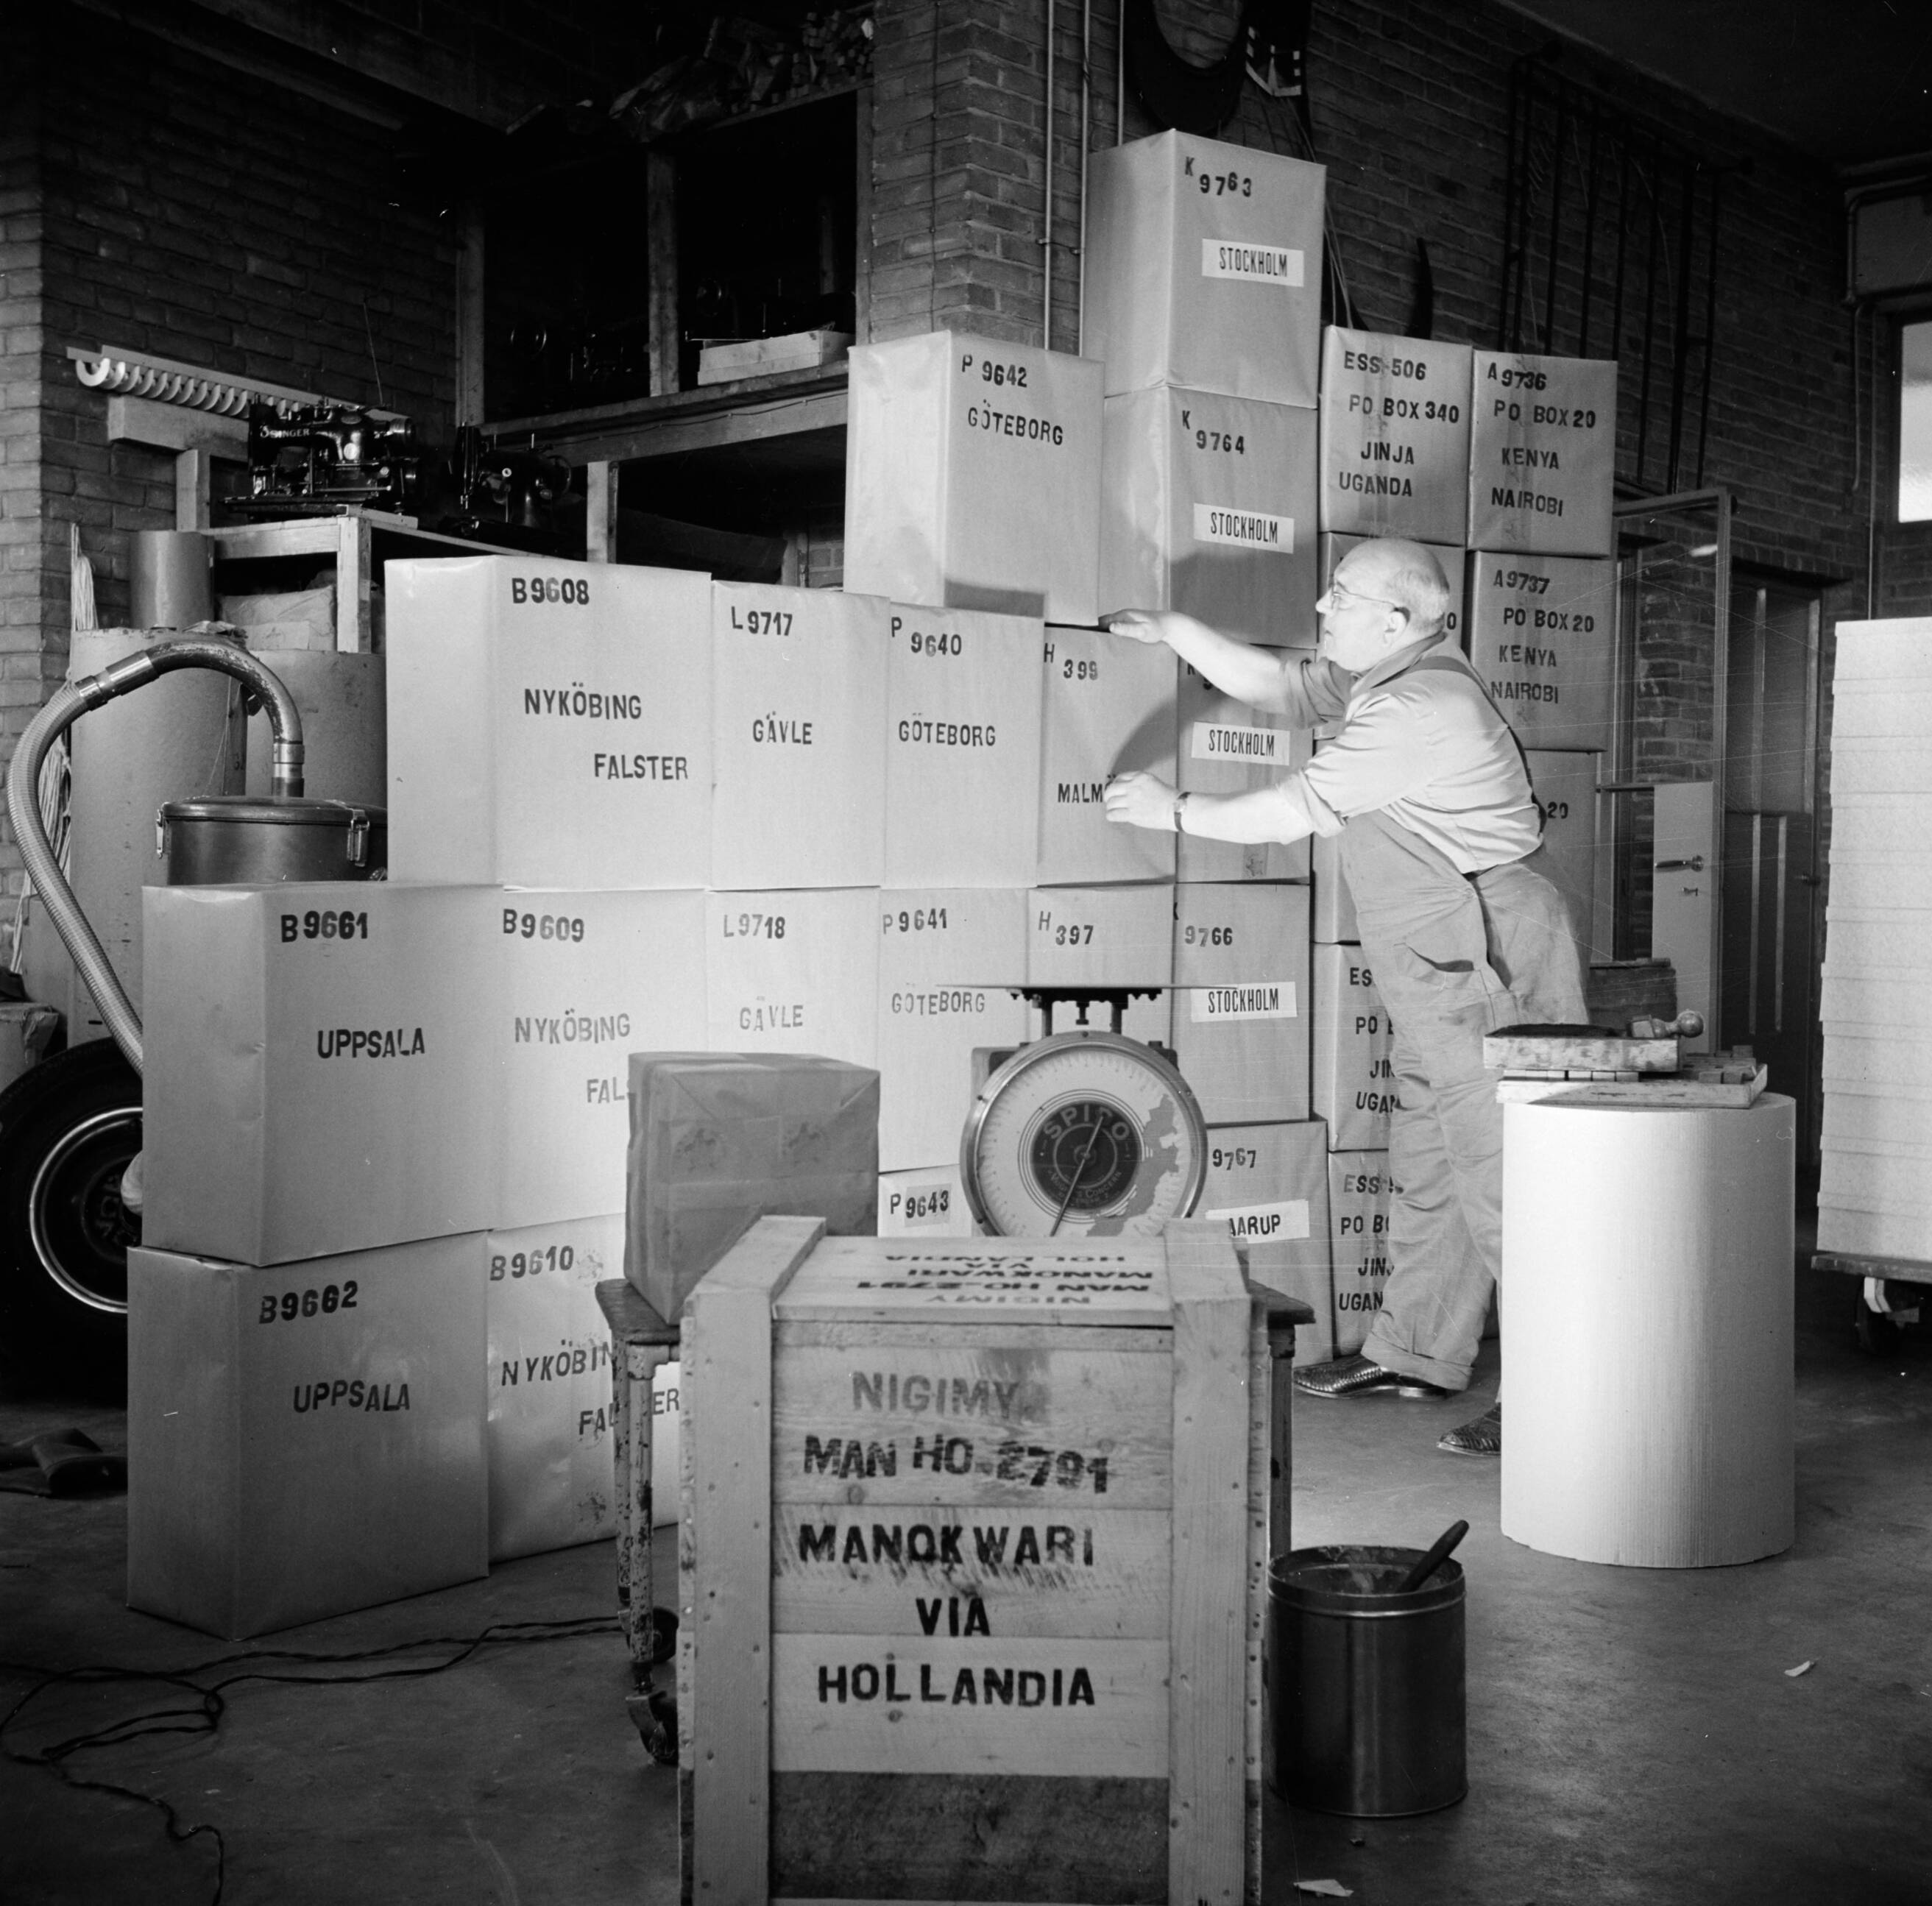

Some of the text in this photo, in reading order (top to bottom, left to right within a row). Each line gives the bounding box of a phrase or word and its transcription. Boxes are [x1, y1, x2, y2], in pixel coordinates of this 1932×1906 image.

[1184, 156, 1252, 198] K 9763
[1219, 247, 1287, 276] STOCKHOLM
[961, 354, 1027, 388] P 9642
[1391, 358, 1427, 381] 506
[967, 399, 1064, 446] GÖTEBORG
[1348, 394, 1459, 424] PO BOX 340
[1493, 399, 1596, 429] PO BOX 20
[1181, 410, 1245, 455] K 9764
[1360, 441, 1415, 465] JINJA
[1501, 447, 1560, 470] KENYA
[1339, 471, 1412, 497] UGANDA
[1491, 486, 1563, 517] NAIROBI
[1210, 511, 1278, 543] STOCKHOLM
[1503, 607, 1595, 633] PO BOX 20
[891, 616, 962, 656] P 9640
[1043, 642, 1098, 681] H 399
[1498, 644, 1557, 667] KENYA
[524, 681, 642, 720] NYKÖBING
[1490, 681, 1559, 704] NAIROBI
[752, 711, 813, 745] GÄVLE
[898, 712, 997, 748] GÖTEBORG
[1209, 729, 1275, 757] STOCKHOLM
[594, 753, 688, 781] FALSTER
[1546, 801, 1569, 820] 20
[1038, 910, 1094, 946] H 397
[1185, 925, 1233, 947] 9766
[1349, 967, 1373, 988] ES
[1208, 988, 1279, 1013] STOCKHOLM
[514, 1007, 631, 1045] NYKÖBING
[1355, 1015, 1379, 1035] PO
[317, 1027, 425, 1059] UPPSALA
[586, 1076, 629, 1105] FAL
[1212, 1147, 1256, 1171] 9767
[1340, 1214, 1390, 1236] PO B
[1056, 1283, 1150, 1292] MAN
[501, 1339, 612, 1386] NYKÖBIN
[293, 1379, 411, 1414] UPPSALA
[852, 1371, 1019, 1420] NIGIMY
[804, 1434, 897, 1479] MAN
[799, 1523, 1094, 1566] MANOKWARI
[915, 1596, 991, 1637] VIA
[818, 1663, 1095, 1707] HOLLANDIA
